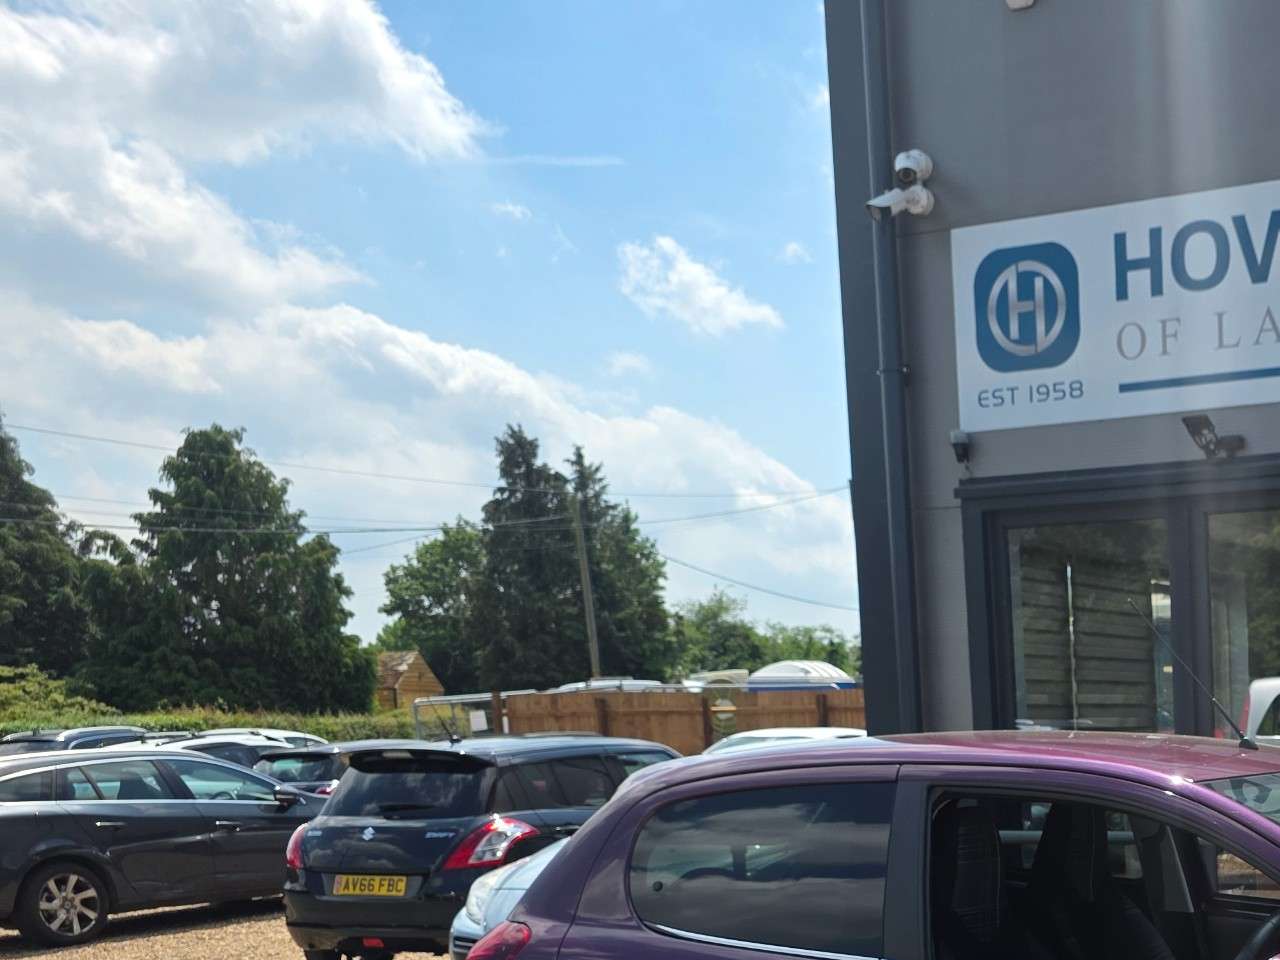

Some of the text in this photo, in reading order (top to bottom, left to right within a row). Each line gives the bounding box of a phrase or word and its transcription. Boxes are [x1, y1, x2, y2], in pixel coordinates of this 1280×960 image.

[1116, 317, 1182, 361] OF
[977, 380, 1085, 408] EST 1958
[342, 876, 405, 893] AV66 FBC
